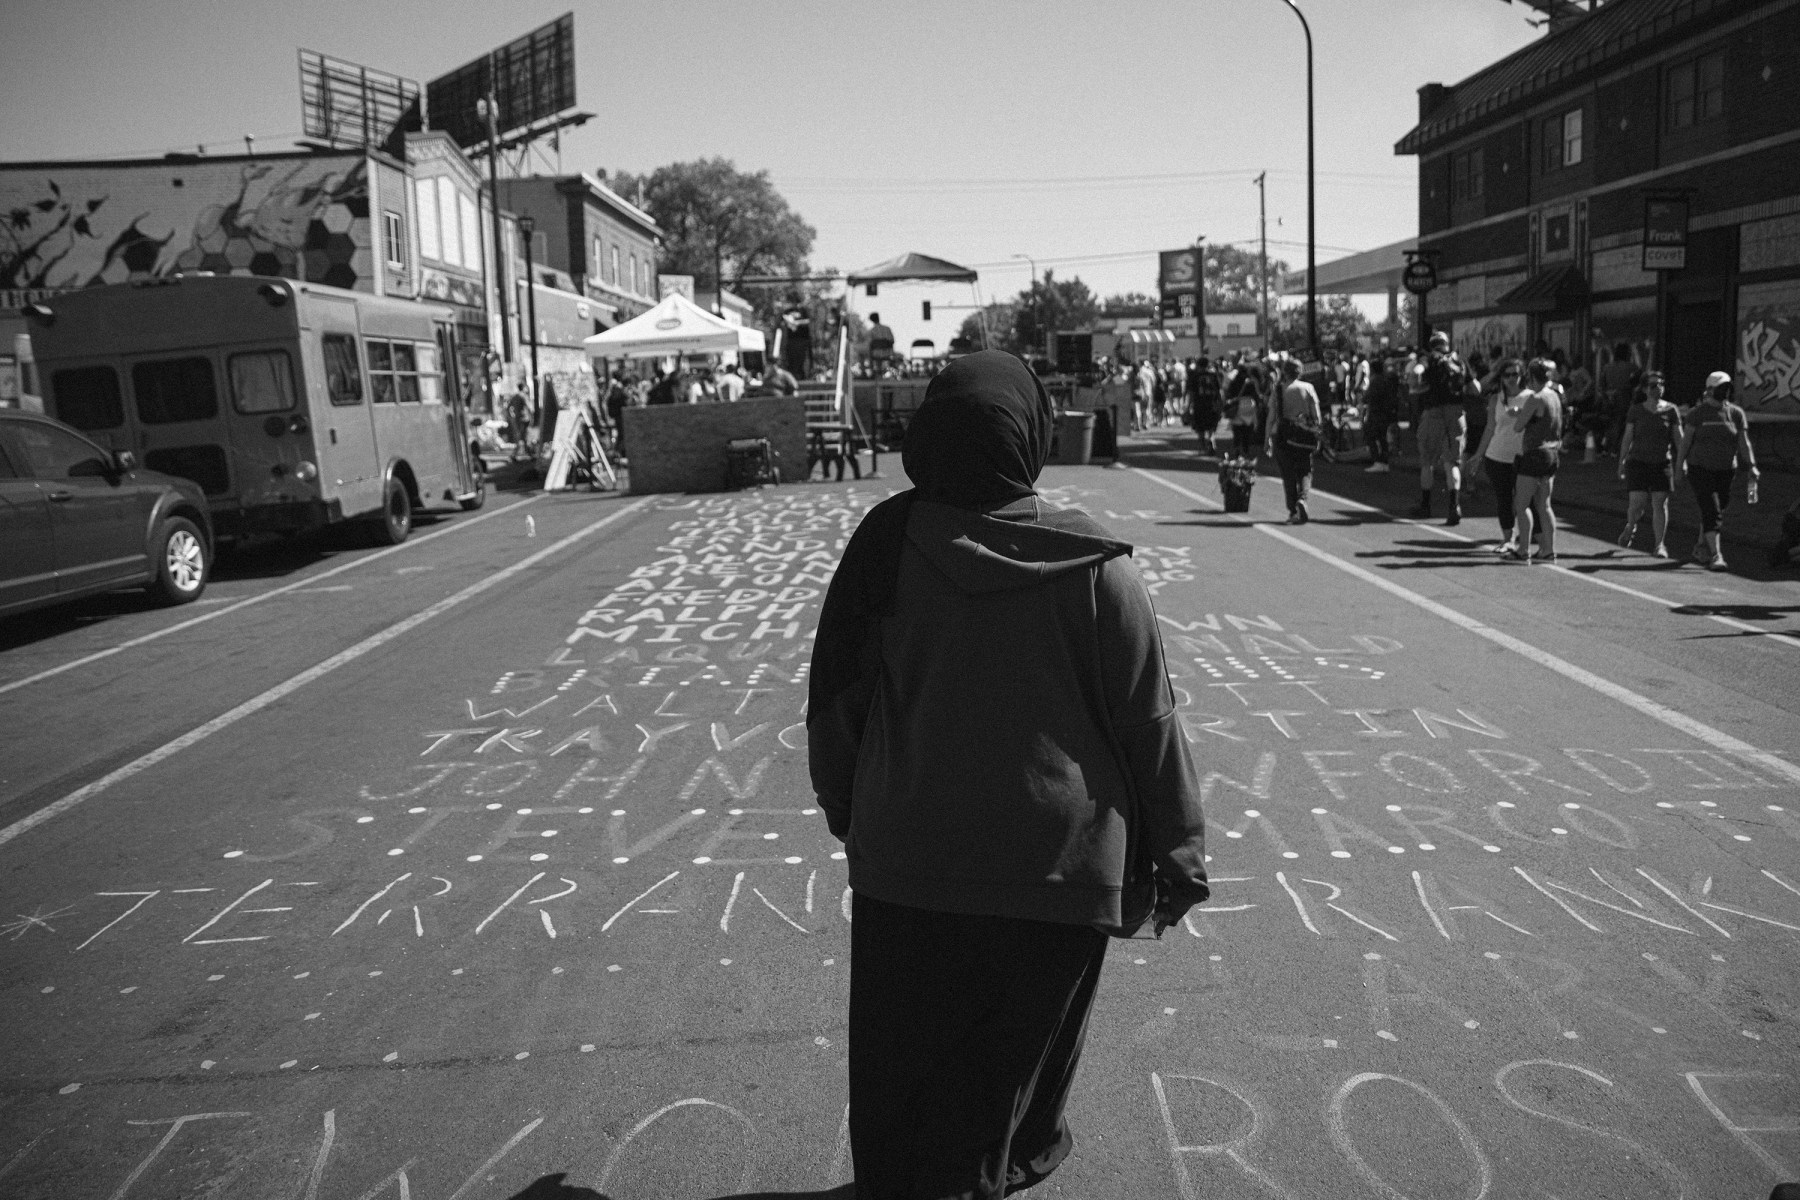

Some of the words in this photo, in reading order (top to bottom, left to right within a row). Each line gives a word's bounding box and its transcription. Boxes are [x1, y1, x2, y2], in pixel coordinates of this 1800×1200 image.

[628, 558, 841, 579] BREON
[649, 550, 834, 568] AHMA
[593, 586, 821, 608] FREDD
[576, 602, 806, 625] RALPH
[356, 755, 774, 802] JOHN
[70, 869, 851, 952] TERRAN
